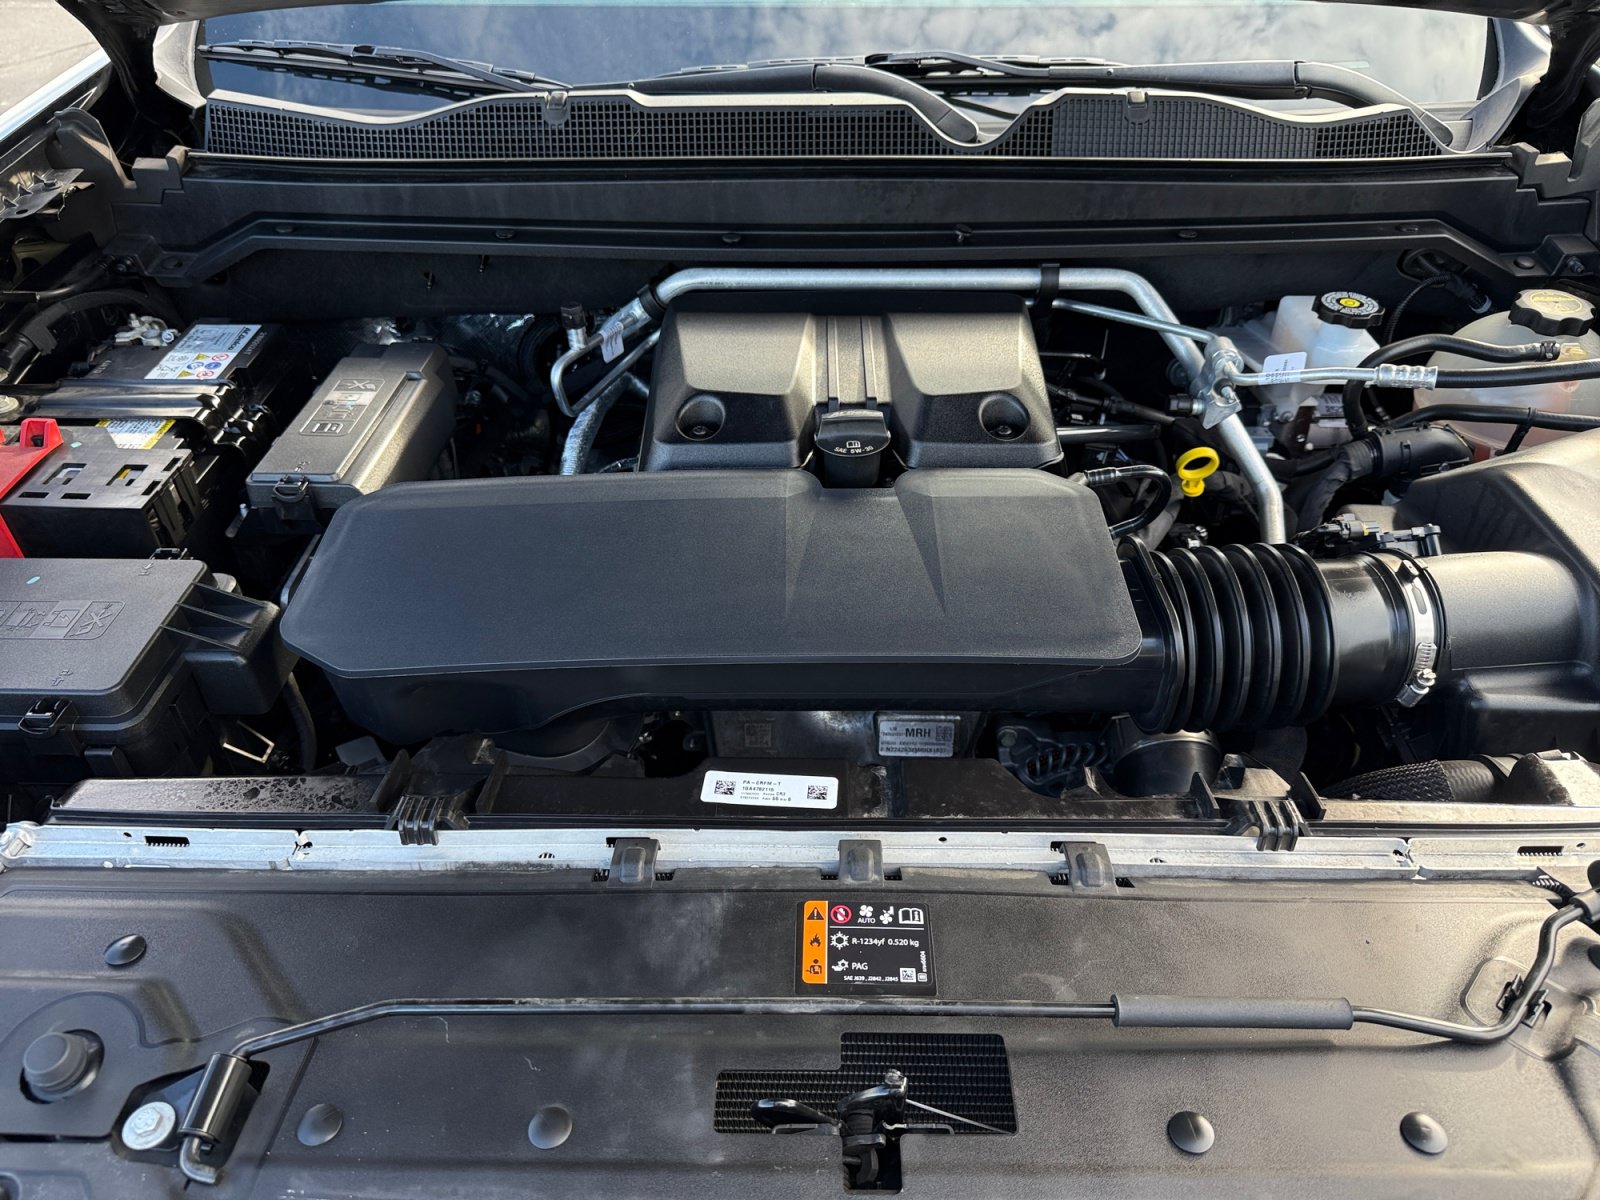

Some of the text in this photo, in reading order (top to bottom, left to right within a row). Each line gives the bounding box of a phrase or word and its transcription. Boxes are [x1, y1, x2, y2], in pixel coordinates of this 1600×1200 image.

[228, 327, 251, 350] ACDelco
[834, 445, 874, 454] SAE 5W-30
[905, 728, 931, 738] MRH
[851, 937, 920, 948] R-1234yf 0.520 kg
[851, 962, 868, 970] PAG
